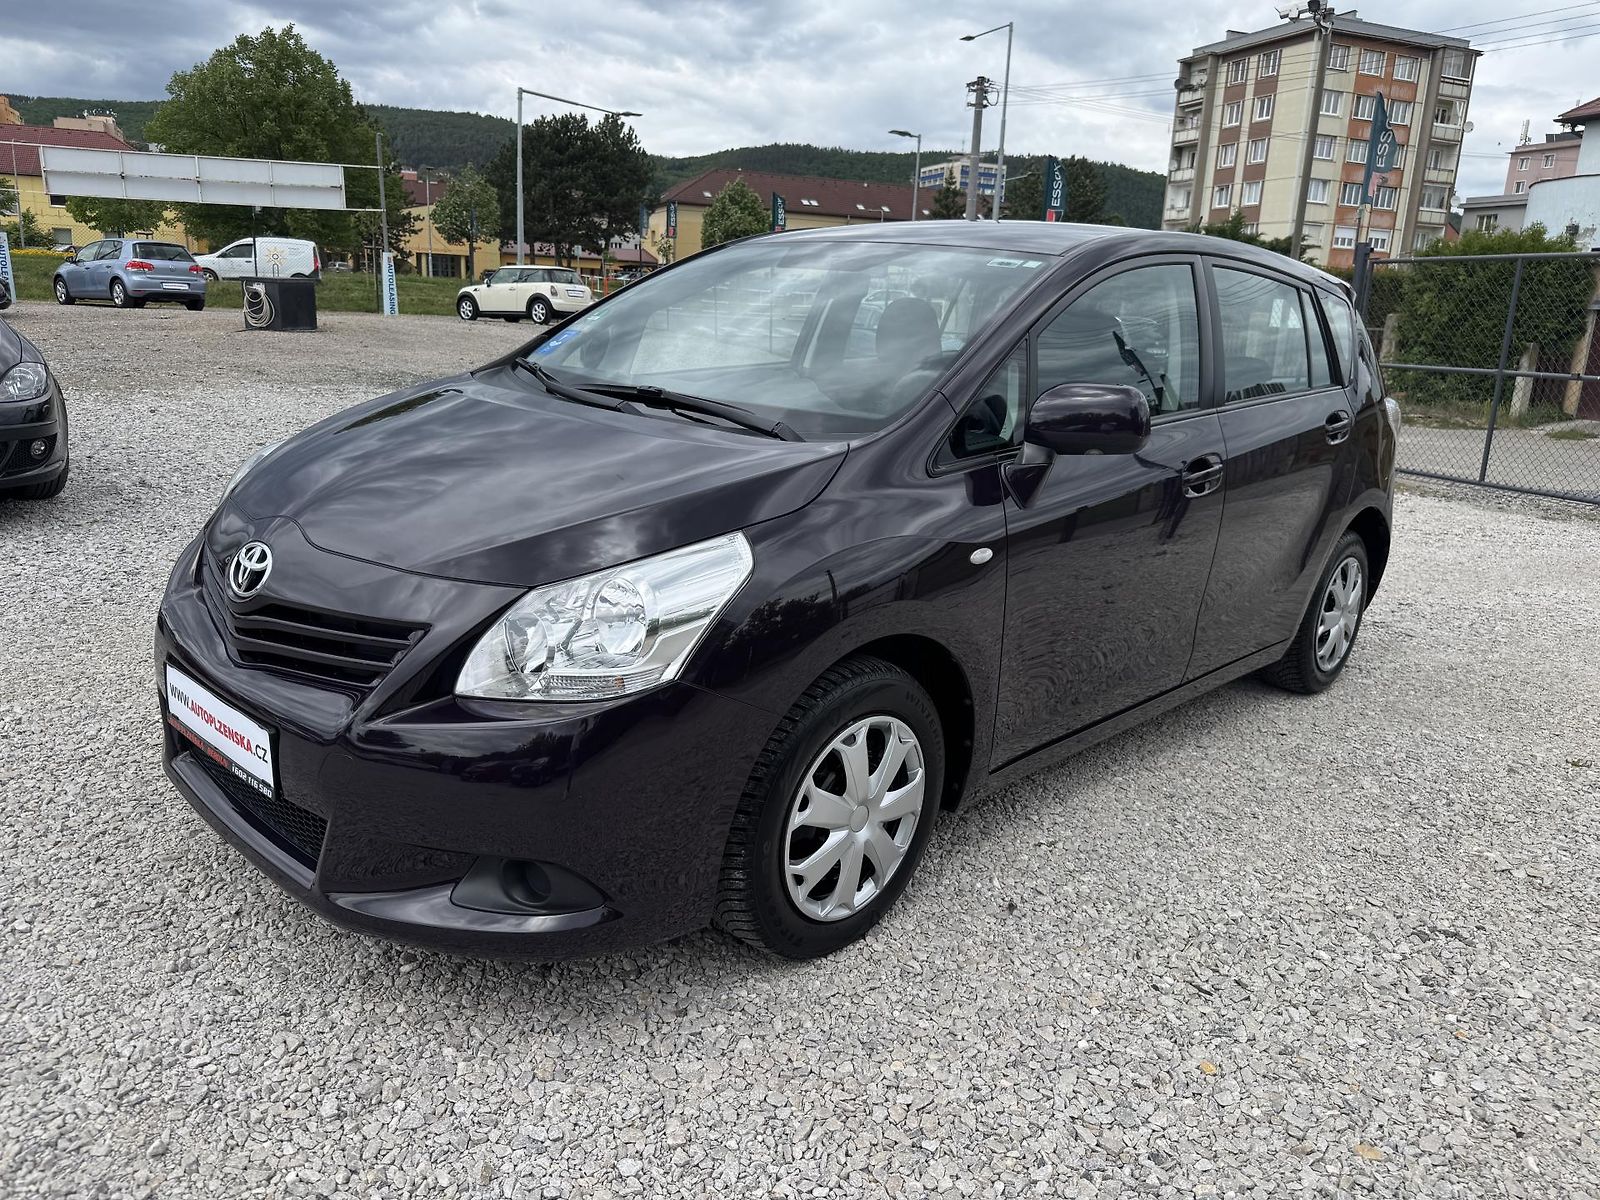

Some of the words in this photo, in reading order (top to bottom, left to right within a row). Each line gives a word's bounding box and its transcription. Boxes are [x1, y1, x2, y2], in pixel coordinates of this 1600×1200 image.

[1376, 118, 1393, 167] ESS
[1051, 162, 1063, 207] ESSOX
[0, 245, 9, 282] AUTOLE
[387, 263, 396, 315] AUTOLEASING
[169, 682, 269, 764] WWW.AUTOPLZENSKA.CZ
